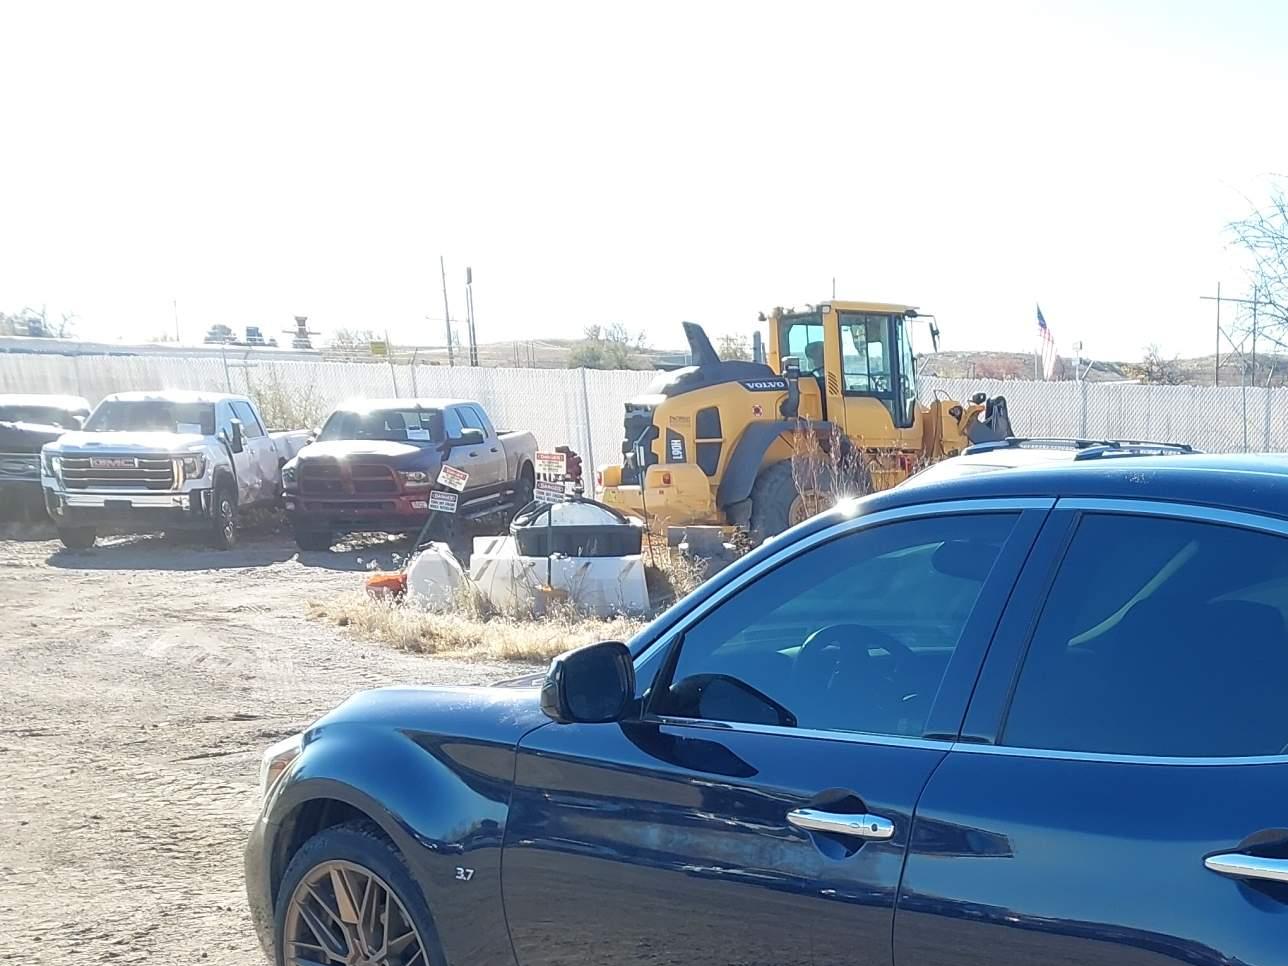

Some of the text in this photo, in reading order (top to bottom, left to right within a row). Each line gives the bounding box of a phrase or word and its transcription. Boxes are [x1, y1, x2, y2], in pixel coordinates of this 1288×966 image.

[746, 381, 785, 389] VOLVO
[670, 439, 683, 460] L90H
[94, 457, 135, 468] GMC
